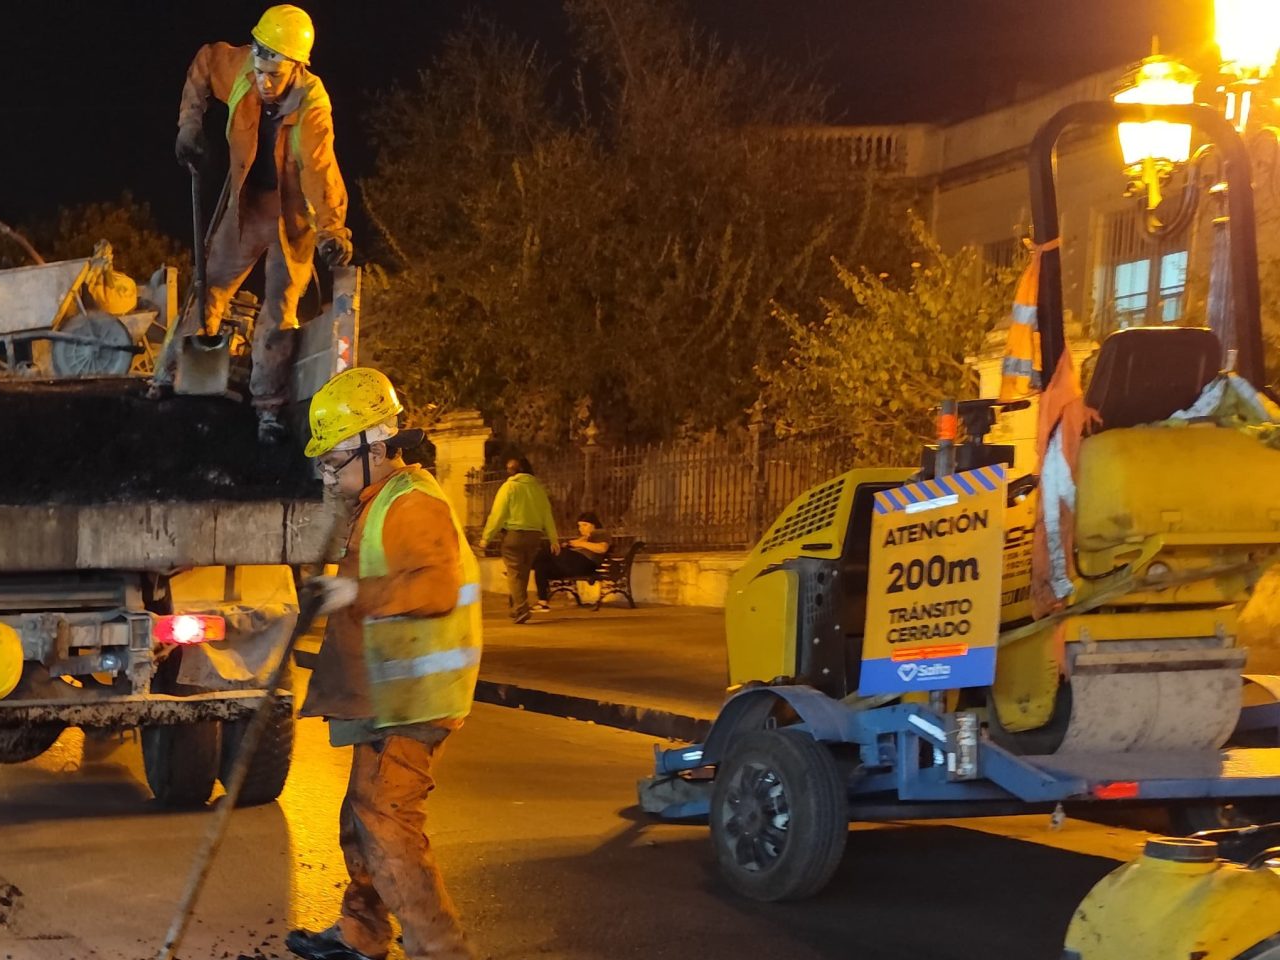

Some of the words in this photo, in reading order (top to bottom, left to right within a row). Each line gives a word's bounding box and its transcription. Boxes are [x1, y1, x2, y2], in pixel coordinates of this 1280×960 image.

[883, 509, 989, 548] ATENCIÓN
[886, 555, 979, 594] 200m
[889, 598, 973, 624] TRÁNSITO
[887, 620, 972, 644] CERRADO
